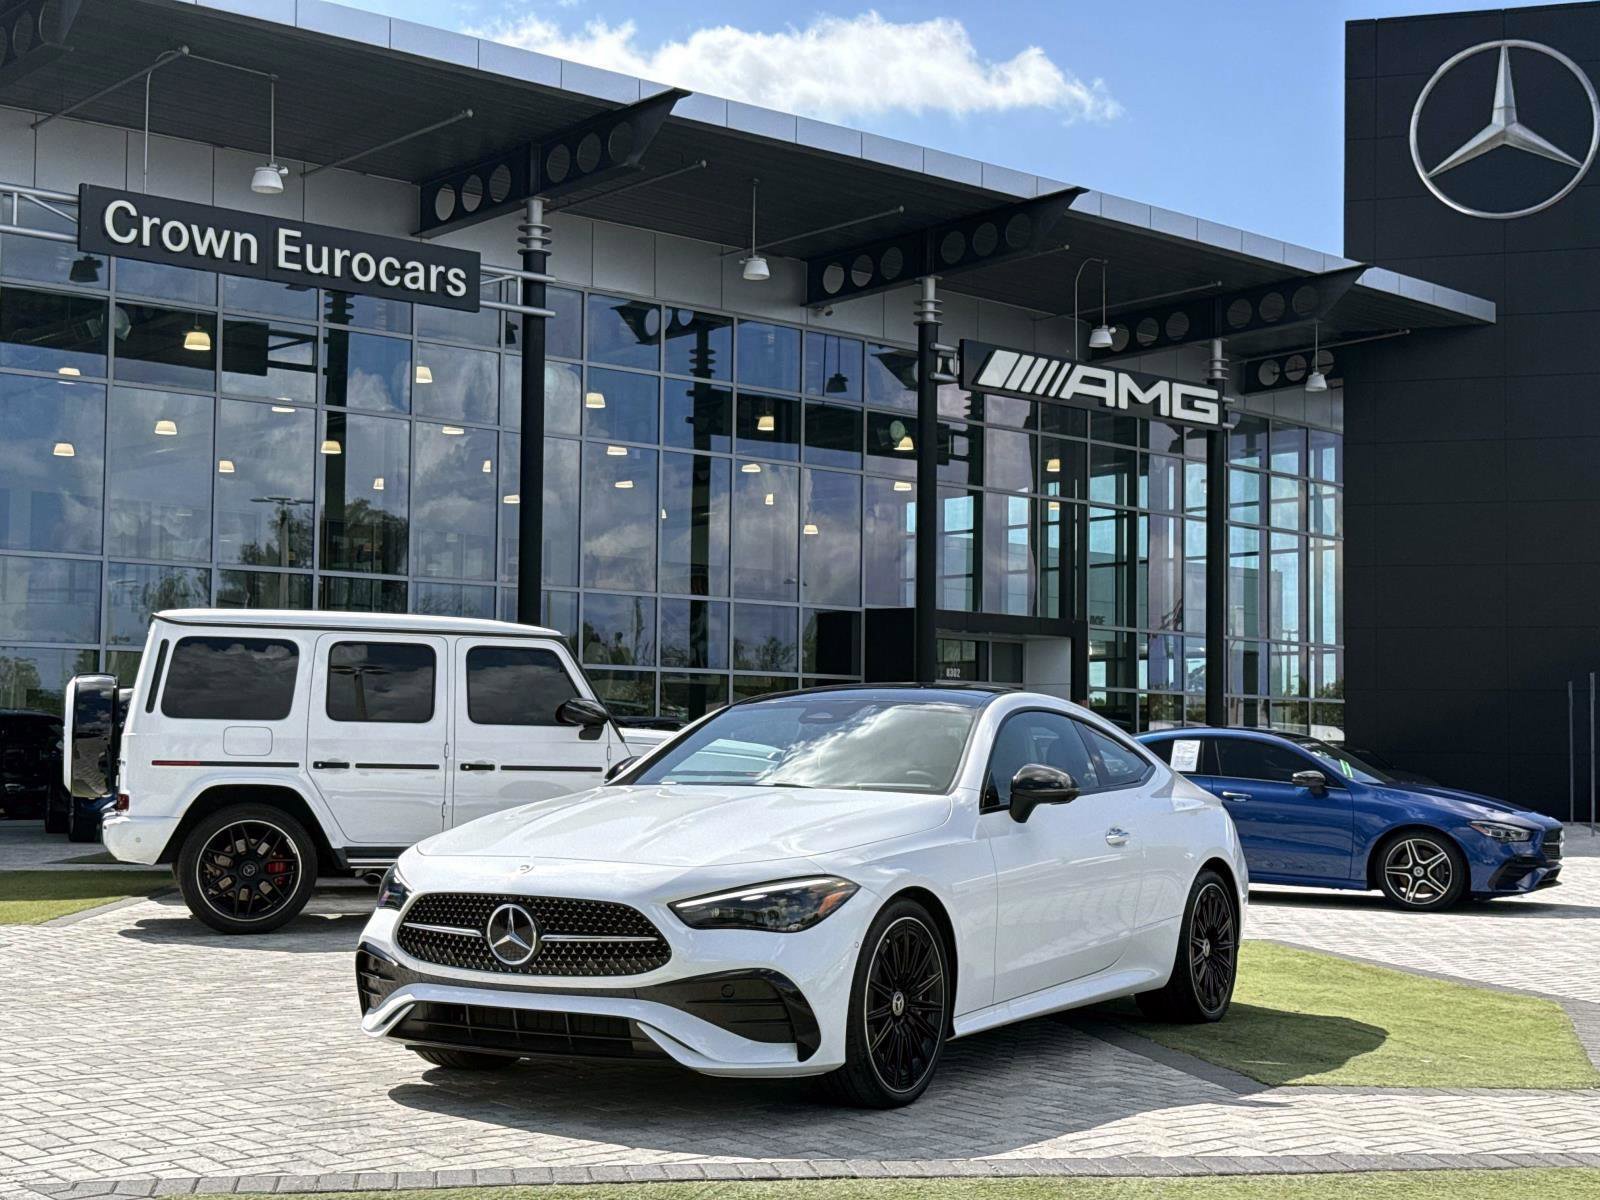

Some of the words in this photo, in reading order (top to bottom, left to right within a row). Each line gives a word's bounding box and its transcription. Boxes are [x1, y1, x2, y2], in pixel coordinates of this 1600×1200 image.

[104, 199, 259, 264] Crown
[277, 227, 468, 298] Eurocars
[1058, 364, 1219, 425] AMG
